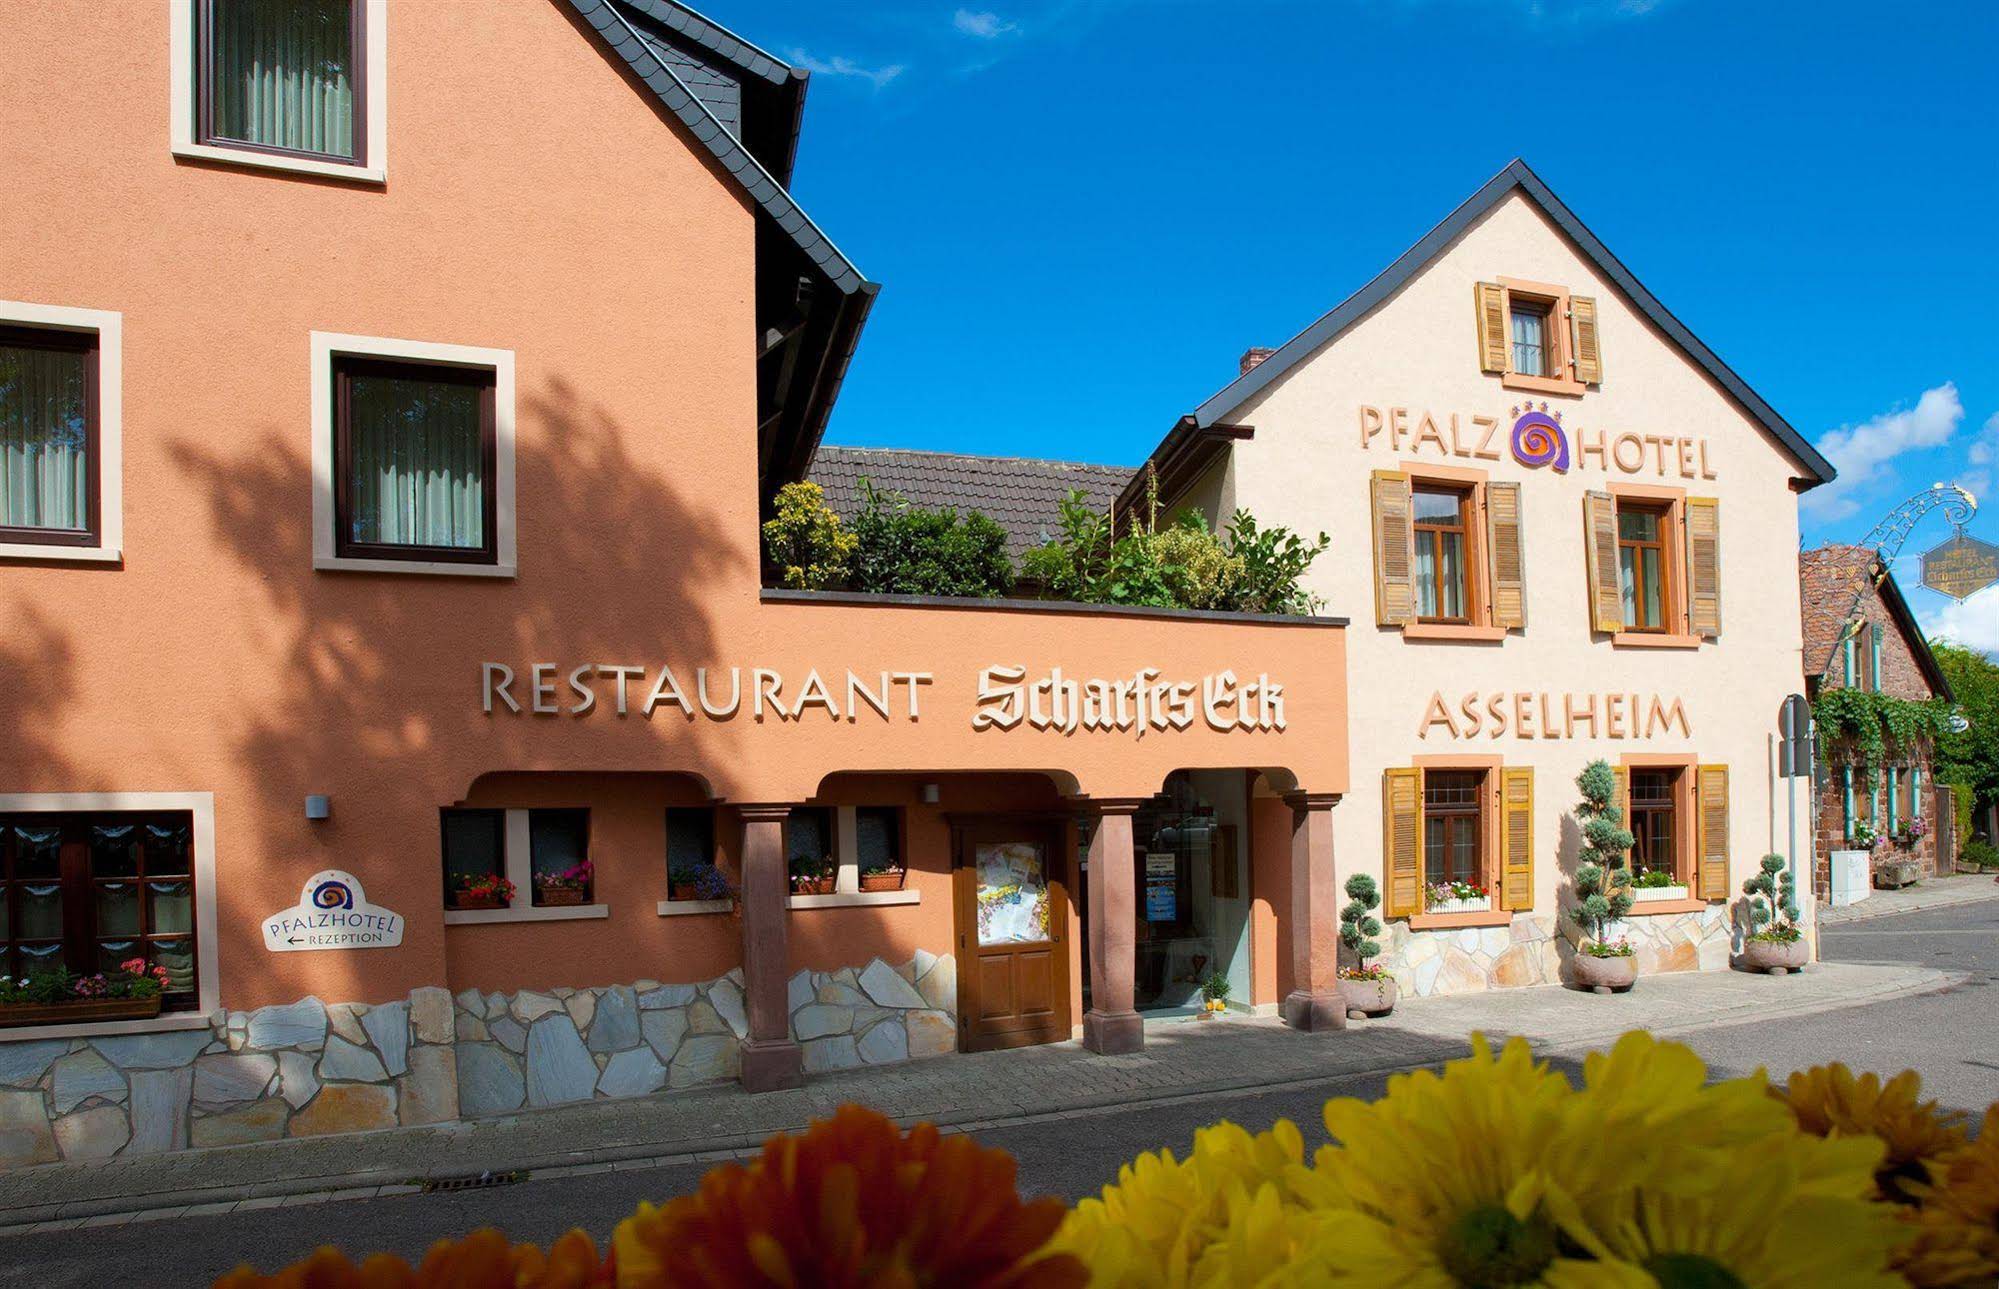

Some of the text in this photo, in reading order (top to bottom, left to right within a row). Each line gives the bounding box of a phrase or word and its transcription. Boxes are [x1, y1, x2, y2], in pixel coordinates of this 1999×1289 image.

[1359, 404, 1719, 480] PFALZ HOTEL
[482, 662, 1287, 741] RESTAURANT Scharfes Eck
[1417, 690, 1692, 740] ASSELHEIM
[270, 913, 395, 937] PFALZHOTEL
[309, 933, 382, 945] REZEPTION
